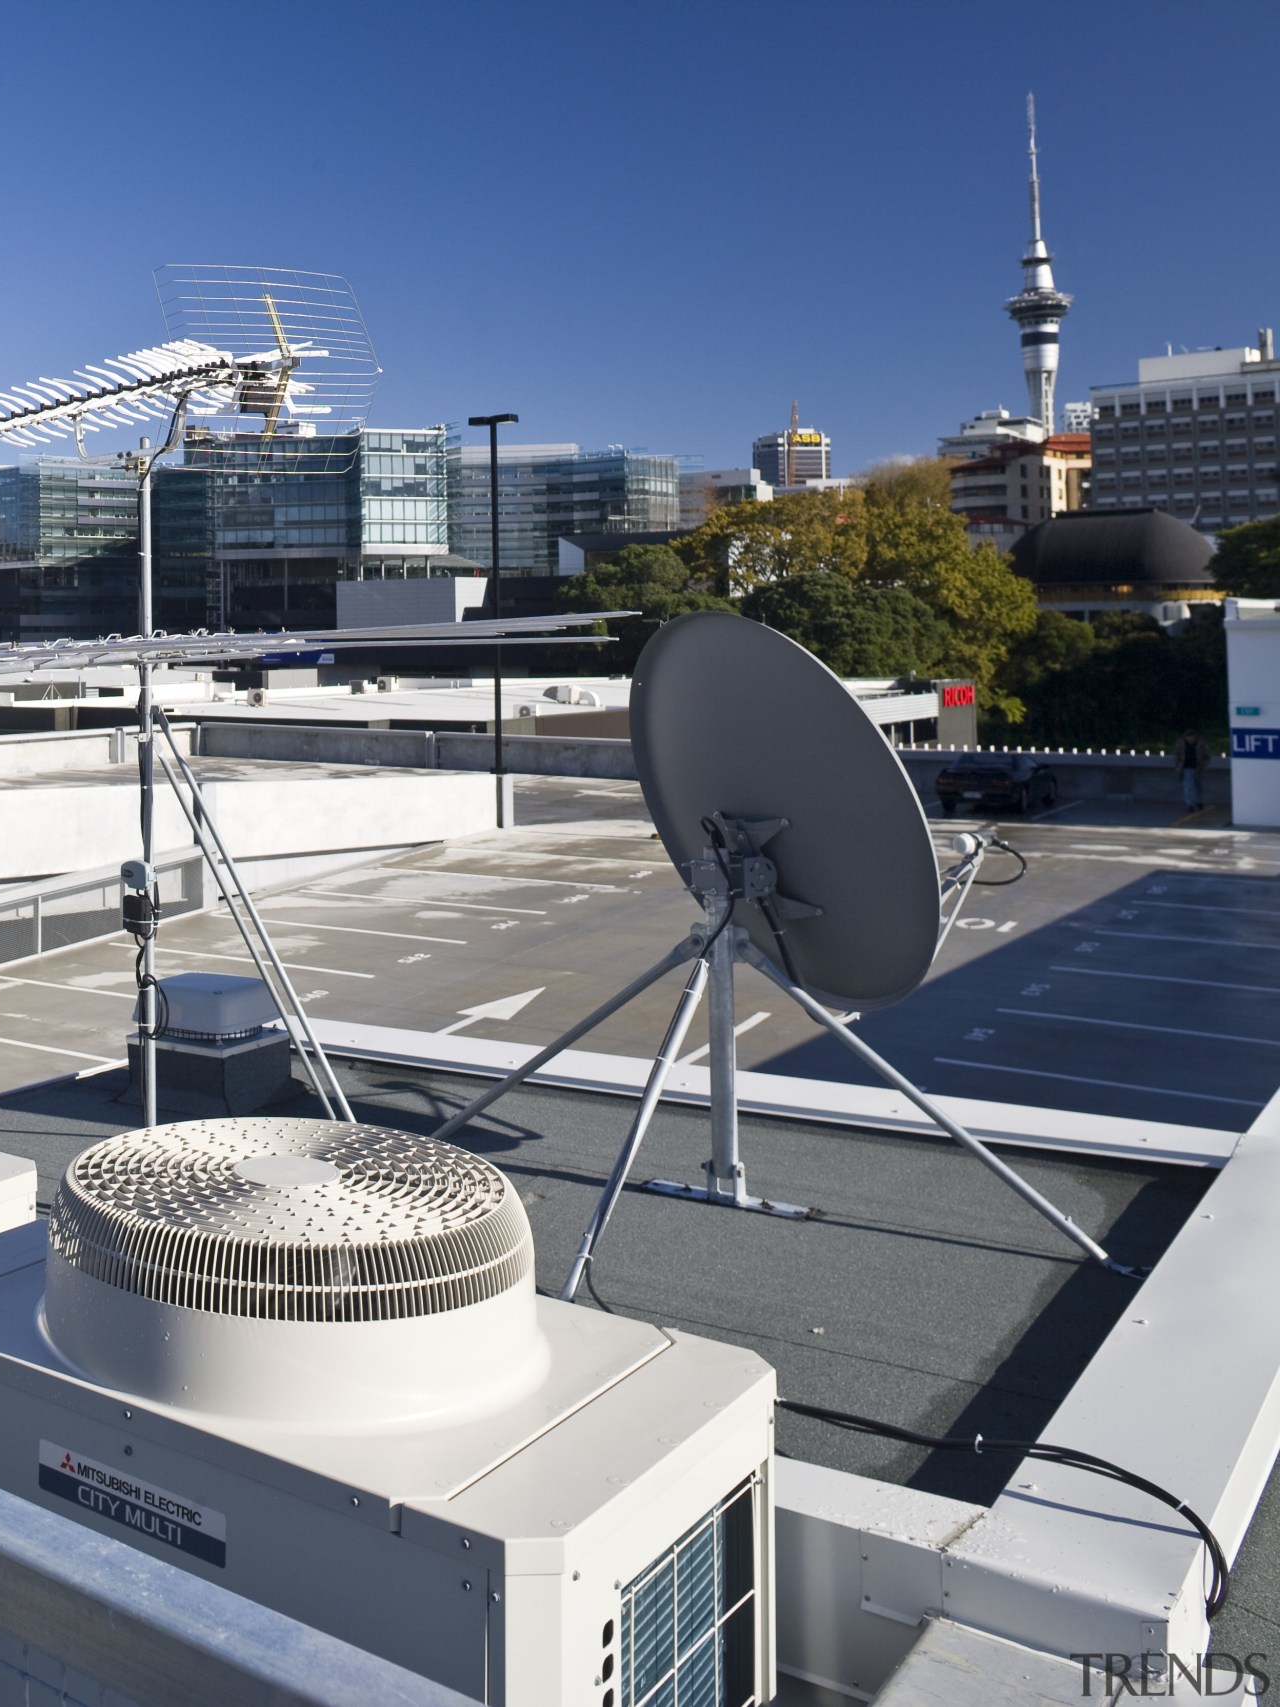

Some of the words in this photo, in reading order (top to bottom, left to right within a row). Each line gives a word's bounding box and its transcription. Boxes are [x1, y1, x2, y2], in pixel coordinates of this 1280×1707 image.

[792, 434, 821, 443] ASB
[943, 685, 974, 707] RICOH
[1233, 734, 1279, 753] LIFT
[77, 1462, 141, 1500] MITSUBISHI
[144, 1491, 202, 1526] ELECTRIC
[78, 1485, 121, 1517] CITY
[125, 1504, 182, 1546] MULTI
